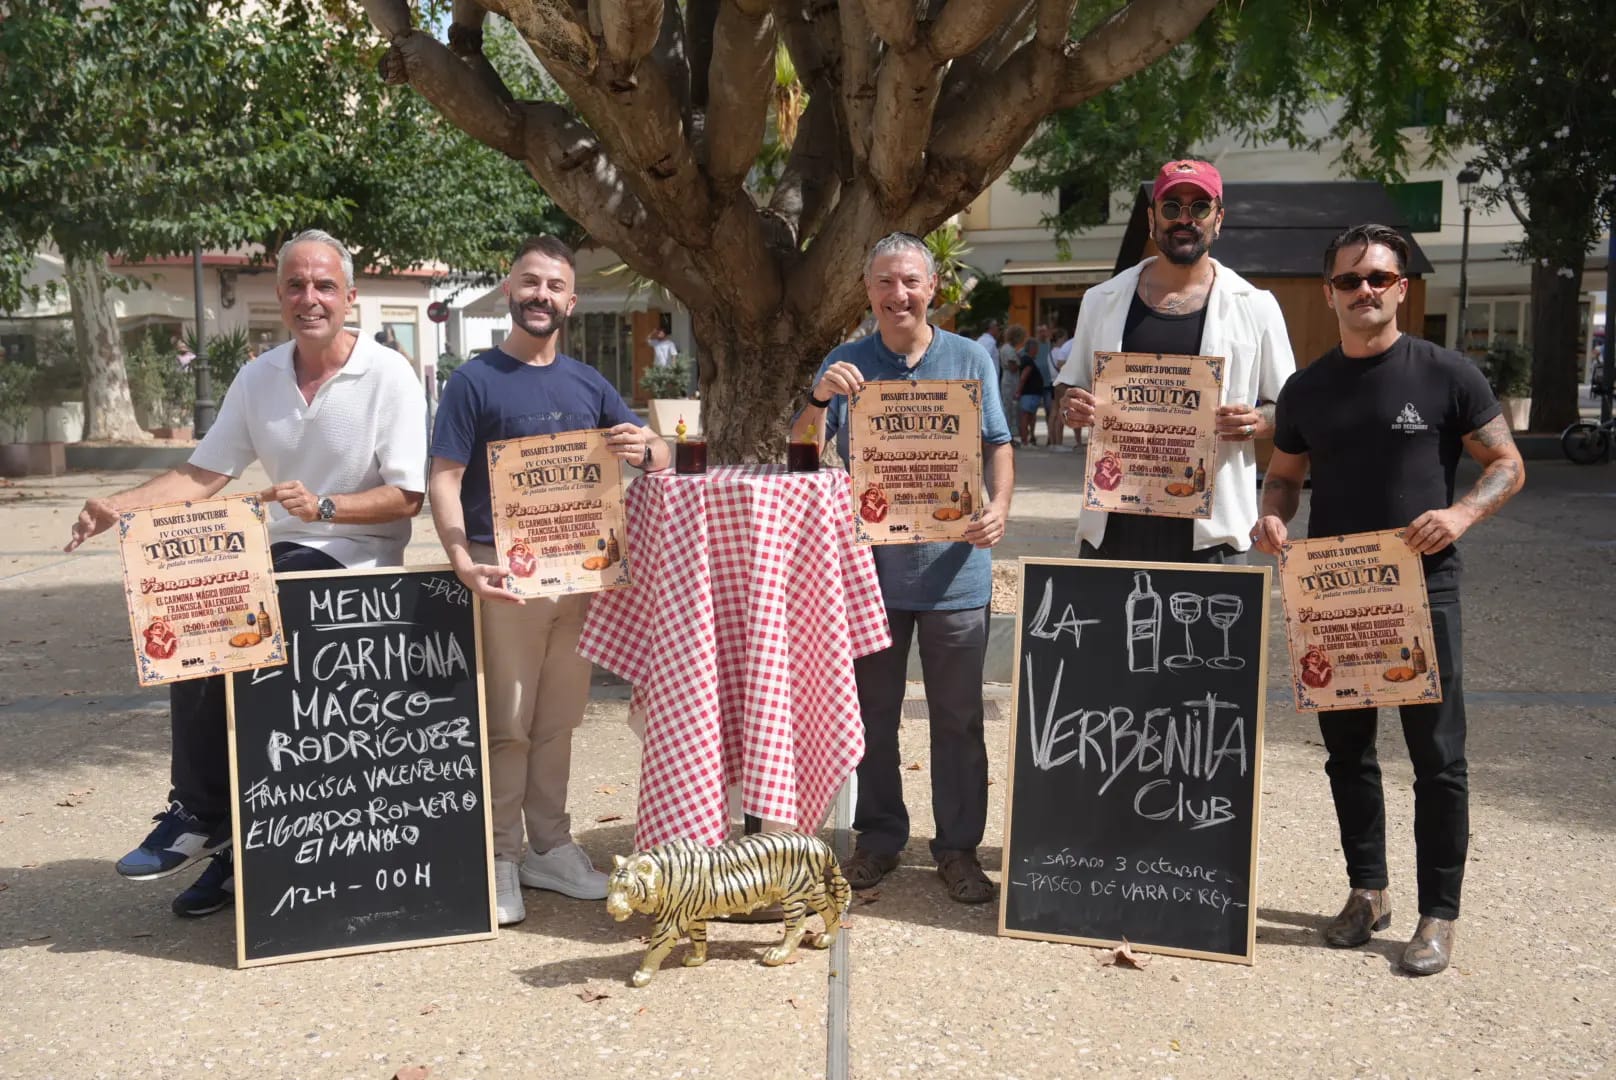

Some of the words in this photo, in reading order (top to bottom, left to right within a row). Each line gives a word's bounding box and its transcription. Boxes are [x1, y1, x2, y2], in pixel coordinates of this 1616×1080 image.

[1125, 364, 1153, 373] DISSABTE
[1138, 377, 1174, 385] CONCURS
[881, 393, 909, 401] DISSABTE
[1113, 385, 1198, 408] TRUITA
[871, 415, 957, 433] TRUITA
[1119, 435, 1144, 444] CARMONA
[863, 451, 959, 461] VERBENITA
[1120, 444, 1149, 453] FRANCISCA
[535, 456, 573, 466] CONCURS
[882, 465, 907, 473] CARMONA
[910, 463, 929, 472] MÁGICO
[512, 463, 599, 489] TRUITA
[883, 474, 913, 482] FRANCISCA
[153, 515, 186, 527] DISSABTE
[171, 525, 213, 537] CONCURS
[145, 532, 244, 563] TRUITA
[1308, 548, 1339, 560] DISSABTE
[1325, 558, 1366, 569] CONCURS
[141, 570, 250, 595] VERBENITA
[1301, 565, 1397, 594] TRUITA
[164, 593, 194, 605] CARMONA
[196, 587, 218, 600] MÁGICO
[309, 578, 403, 623] MENÚ
[167, 602, 202, 614] FRANCISCA
[204, 595, 244, 608] VALENZUELA
[226, 603, 249, 613] MANOLO
[1028, 577, 1101, 648] LA
[1298, 603, 1403, 624] VERBENITA
[1319, 624, 1348, 634] CARMONA
[1322, 633, 1356, 643] FRANCISCA
[1358, 628, 1398, 640] VALENZUELA
[312, 631, 470, 682] CARMONA
[273, 811, 362, 847] GORDO
[364, 790, 477, 825] ROMERO
[1042, 848, 1104, 868] SÁBADO
[1115, 857, 1127, 871] 3
[270, 881, 337, 916] 12H
[1027, 872, 1082, 895] PASEO
[1091, 880, 1116, 896] DE
[1121, 882, 1169, 902] VARA
[1173, 887, 1193, 903] DE
[1199, 889, 1236, 914] REY
